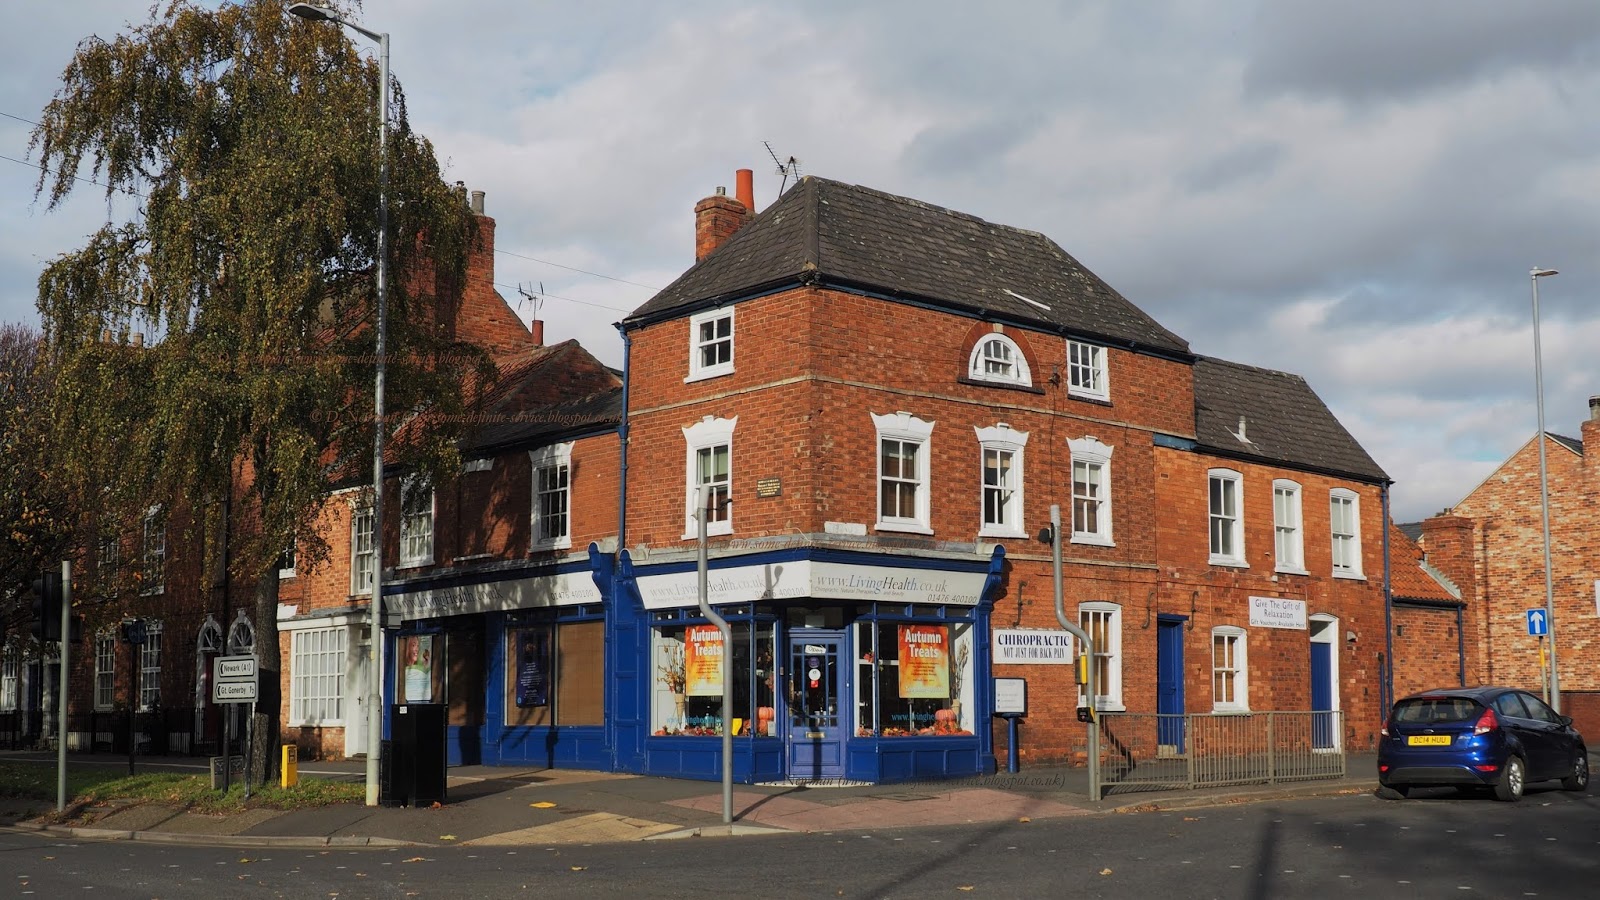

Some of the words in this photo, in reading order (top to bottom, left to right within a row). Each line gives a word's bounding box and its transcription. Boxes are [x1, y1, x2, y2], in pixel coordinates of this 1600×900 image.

[816, 574, 948, 595] www.LivingHealth.co.uk
[927, 594, 950, 603] 01476
[951, 595, 978, 604] 400100
[1255, 599, 1267, 608] Give
[1270, 600, 1280, 609] The
[1282, 601, 1293, 610] Gift
[1294, 602, 1301, 610] of
[1263, 608, 1294, 619] Relaxation
[905, 629, 942, 644] Autumn
[998, 634, 1070, 647] CHIROPRACTIC
[694, 643, 721, 657] Treats
[909, 644, 940, 658] Treats
[1003, 647, 1013, 659] NOT
[1015, 647, 1027, 659] JUST
[1028, 648, 1039, 659] FOR
[1040, 648, 1052, 659] BACK
[1053, 648, 1065, 659] PAIN
[223, 664, 240, 673] Newark
[228, 686, 246, 695] Gonerby
